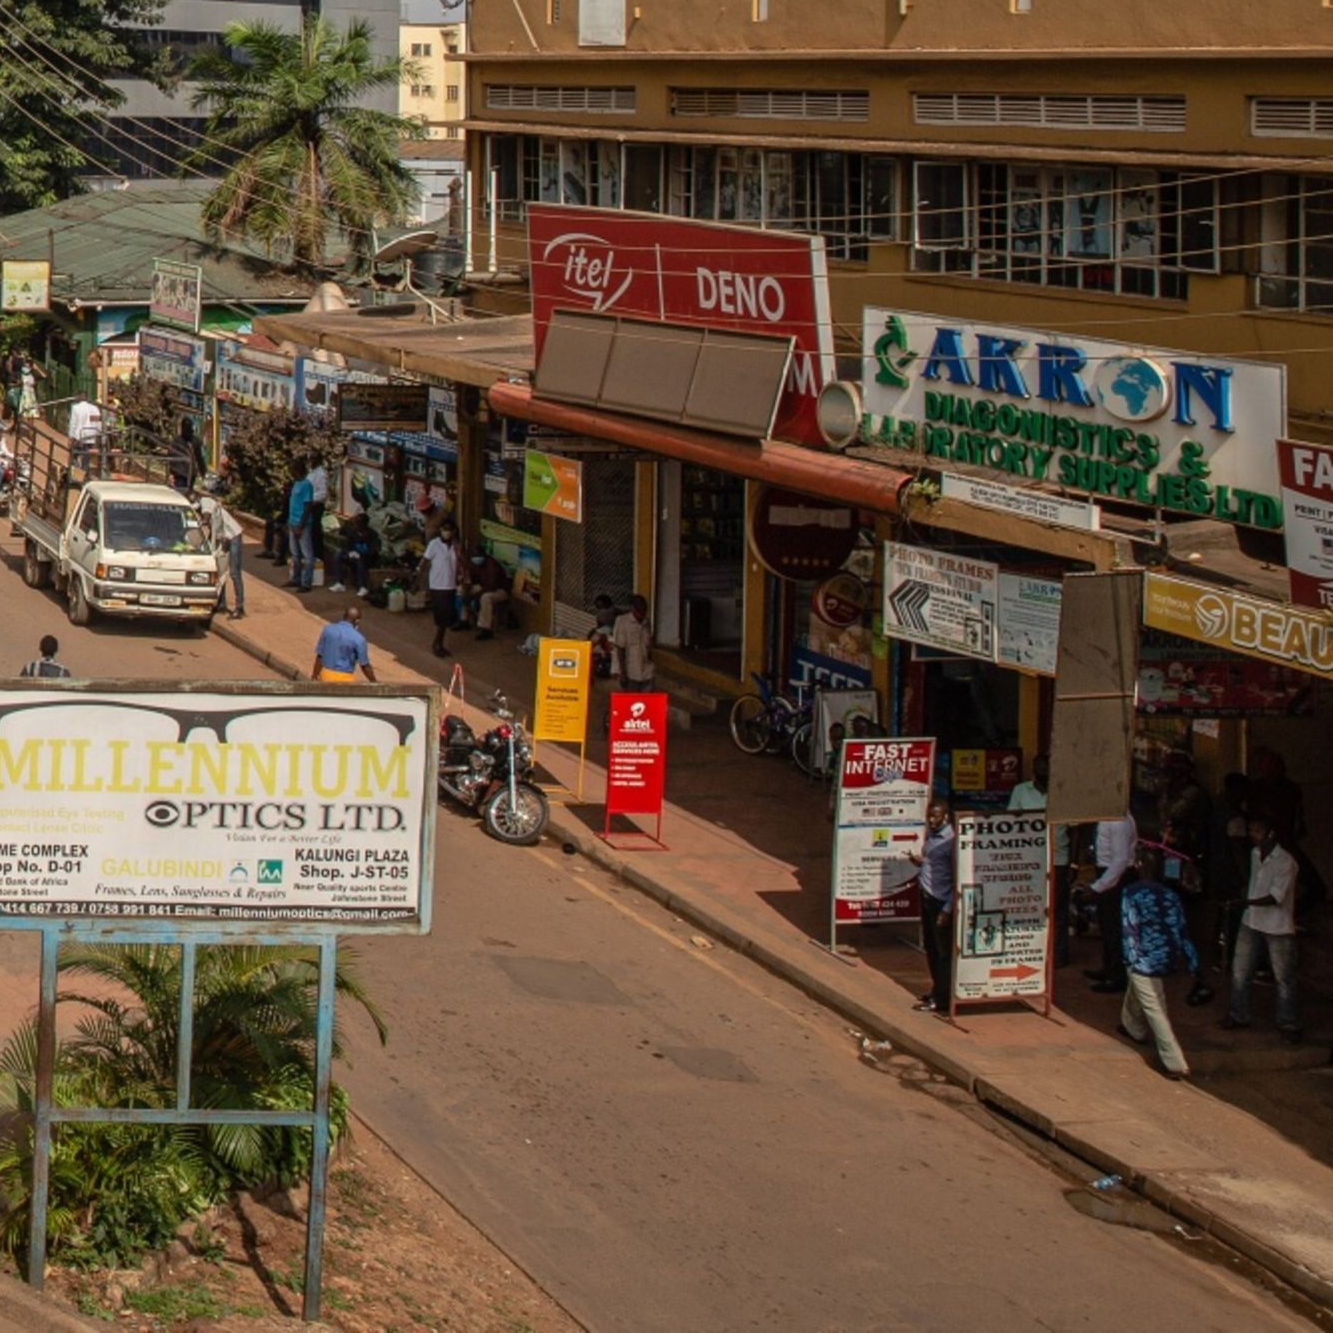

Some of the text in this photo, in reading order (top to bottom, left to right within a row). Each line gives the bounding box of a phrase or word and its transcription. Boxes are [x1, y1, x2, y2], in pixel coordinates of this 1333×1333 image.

[564, 244, 785, 323] itel DENO
[1179, 439, 1211, 479] &
[1058, 455, 1214, 516] SUPPLIES
[1215, 484, 1284, 530] LTD
[888, 543, 994, 581] PHOTO FRAMES
[623, 718, 651, 730] airtel
[863, 743, 913, 761] FAST
[845, 758, 929, 775] INTERNET
[58, 807, 82, 820] Eye
[84, 809, 126, 822] Testing
[144, 799, 407, 832] OPTICS LTD.
[959, 818, 1047, 836] PHOTO
[960, 836, 1046, 850] FRAMING
[21, 844, 89, 858] COMPLEX
[294, 848, 410, 863] KALUNGI PLAZA
[17, 860, 43, 873] No.
[48, 860, 82, 874] D-01
[100, 858, 222, 879] GALUBINDI
[299, 864, 409, 881] Shop. J-ST-05
[5, 877, 28, 886] Bank
[29, 877, 39, 886] of
[41, 877, 69, 886] Africa
[293, 883, 315, 891] Near
[317, 883, 348, 894] Quality
[20, 887, 49, 897] Street
[232, 887, 244, 898] &
[246, 887, 287, 902] Repairs
[1008, 885, 1034, 894] ALL
[999, 894, 1042, 905] PHOTO
[148, 905, 171, 916] 841
[174, 905, 216, 917] Email:
